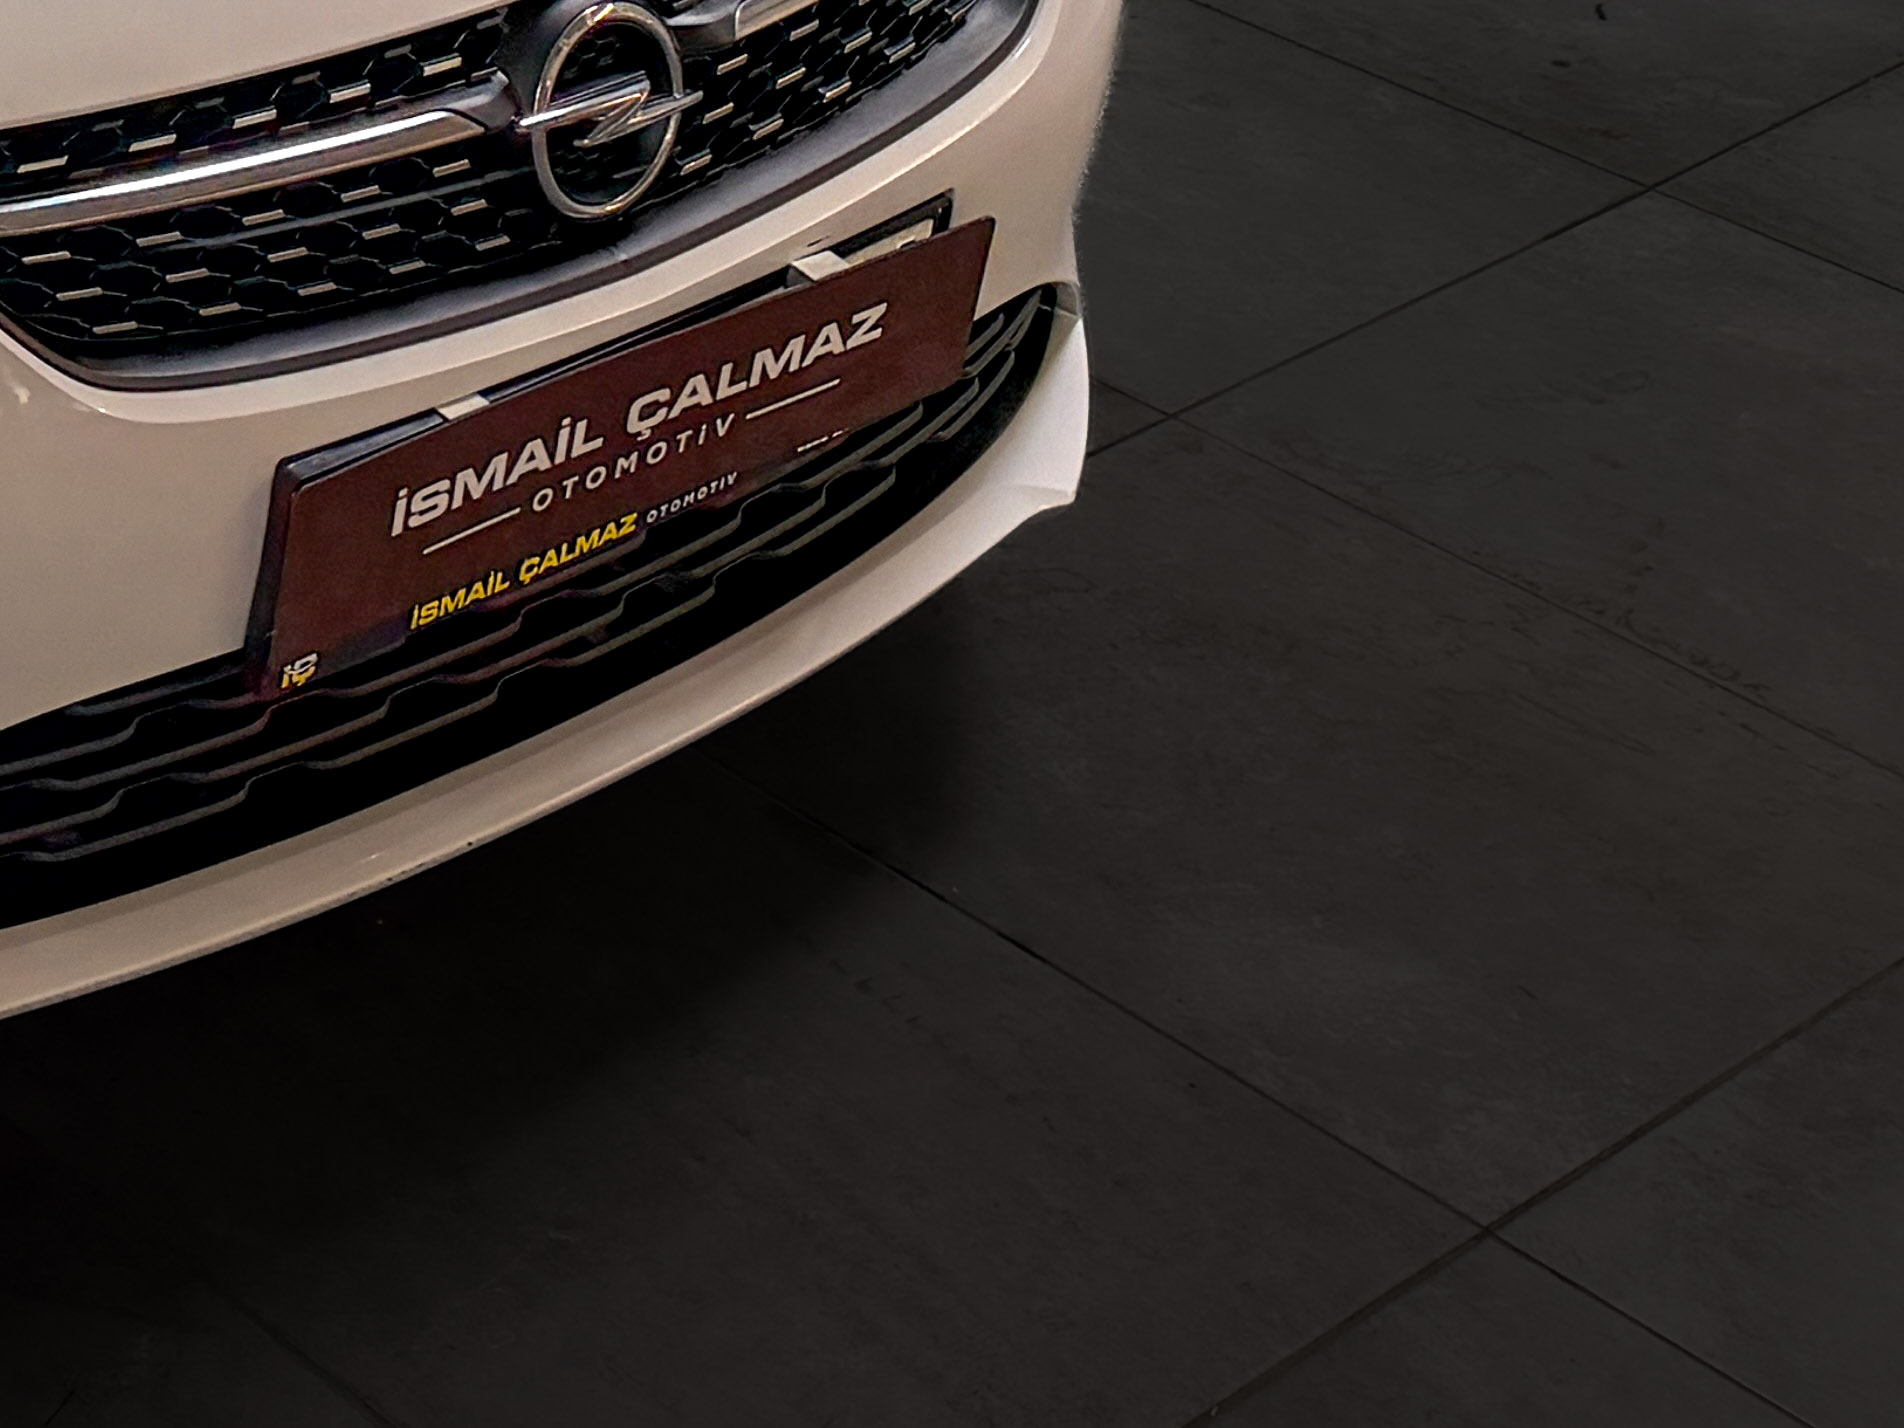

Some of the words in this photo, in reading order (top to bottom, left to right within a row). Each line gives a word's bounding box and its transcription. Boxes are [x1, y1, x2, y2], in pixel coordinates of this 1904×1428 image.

[392, 416, 603, 536] İSMAİL
[626, 302, 889, 441] ÇALMAZ
[409, 570, 510, 631] İSMAİL
[518, 513, 639, 585] ÇALMAZ
